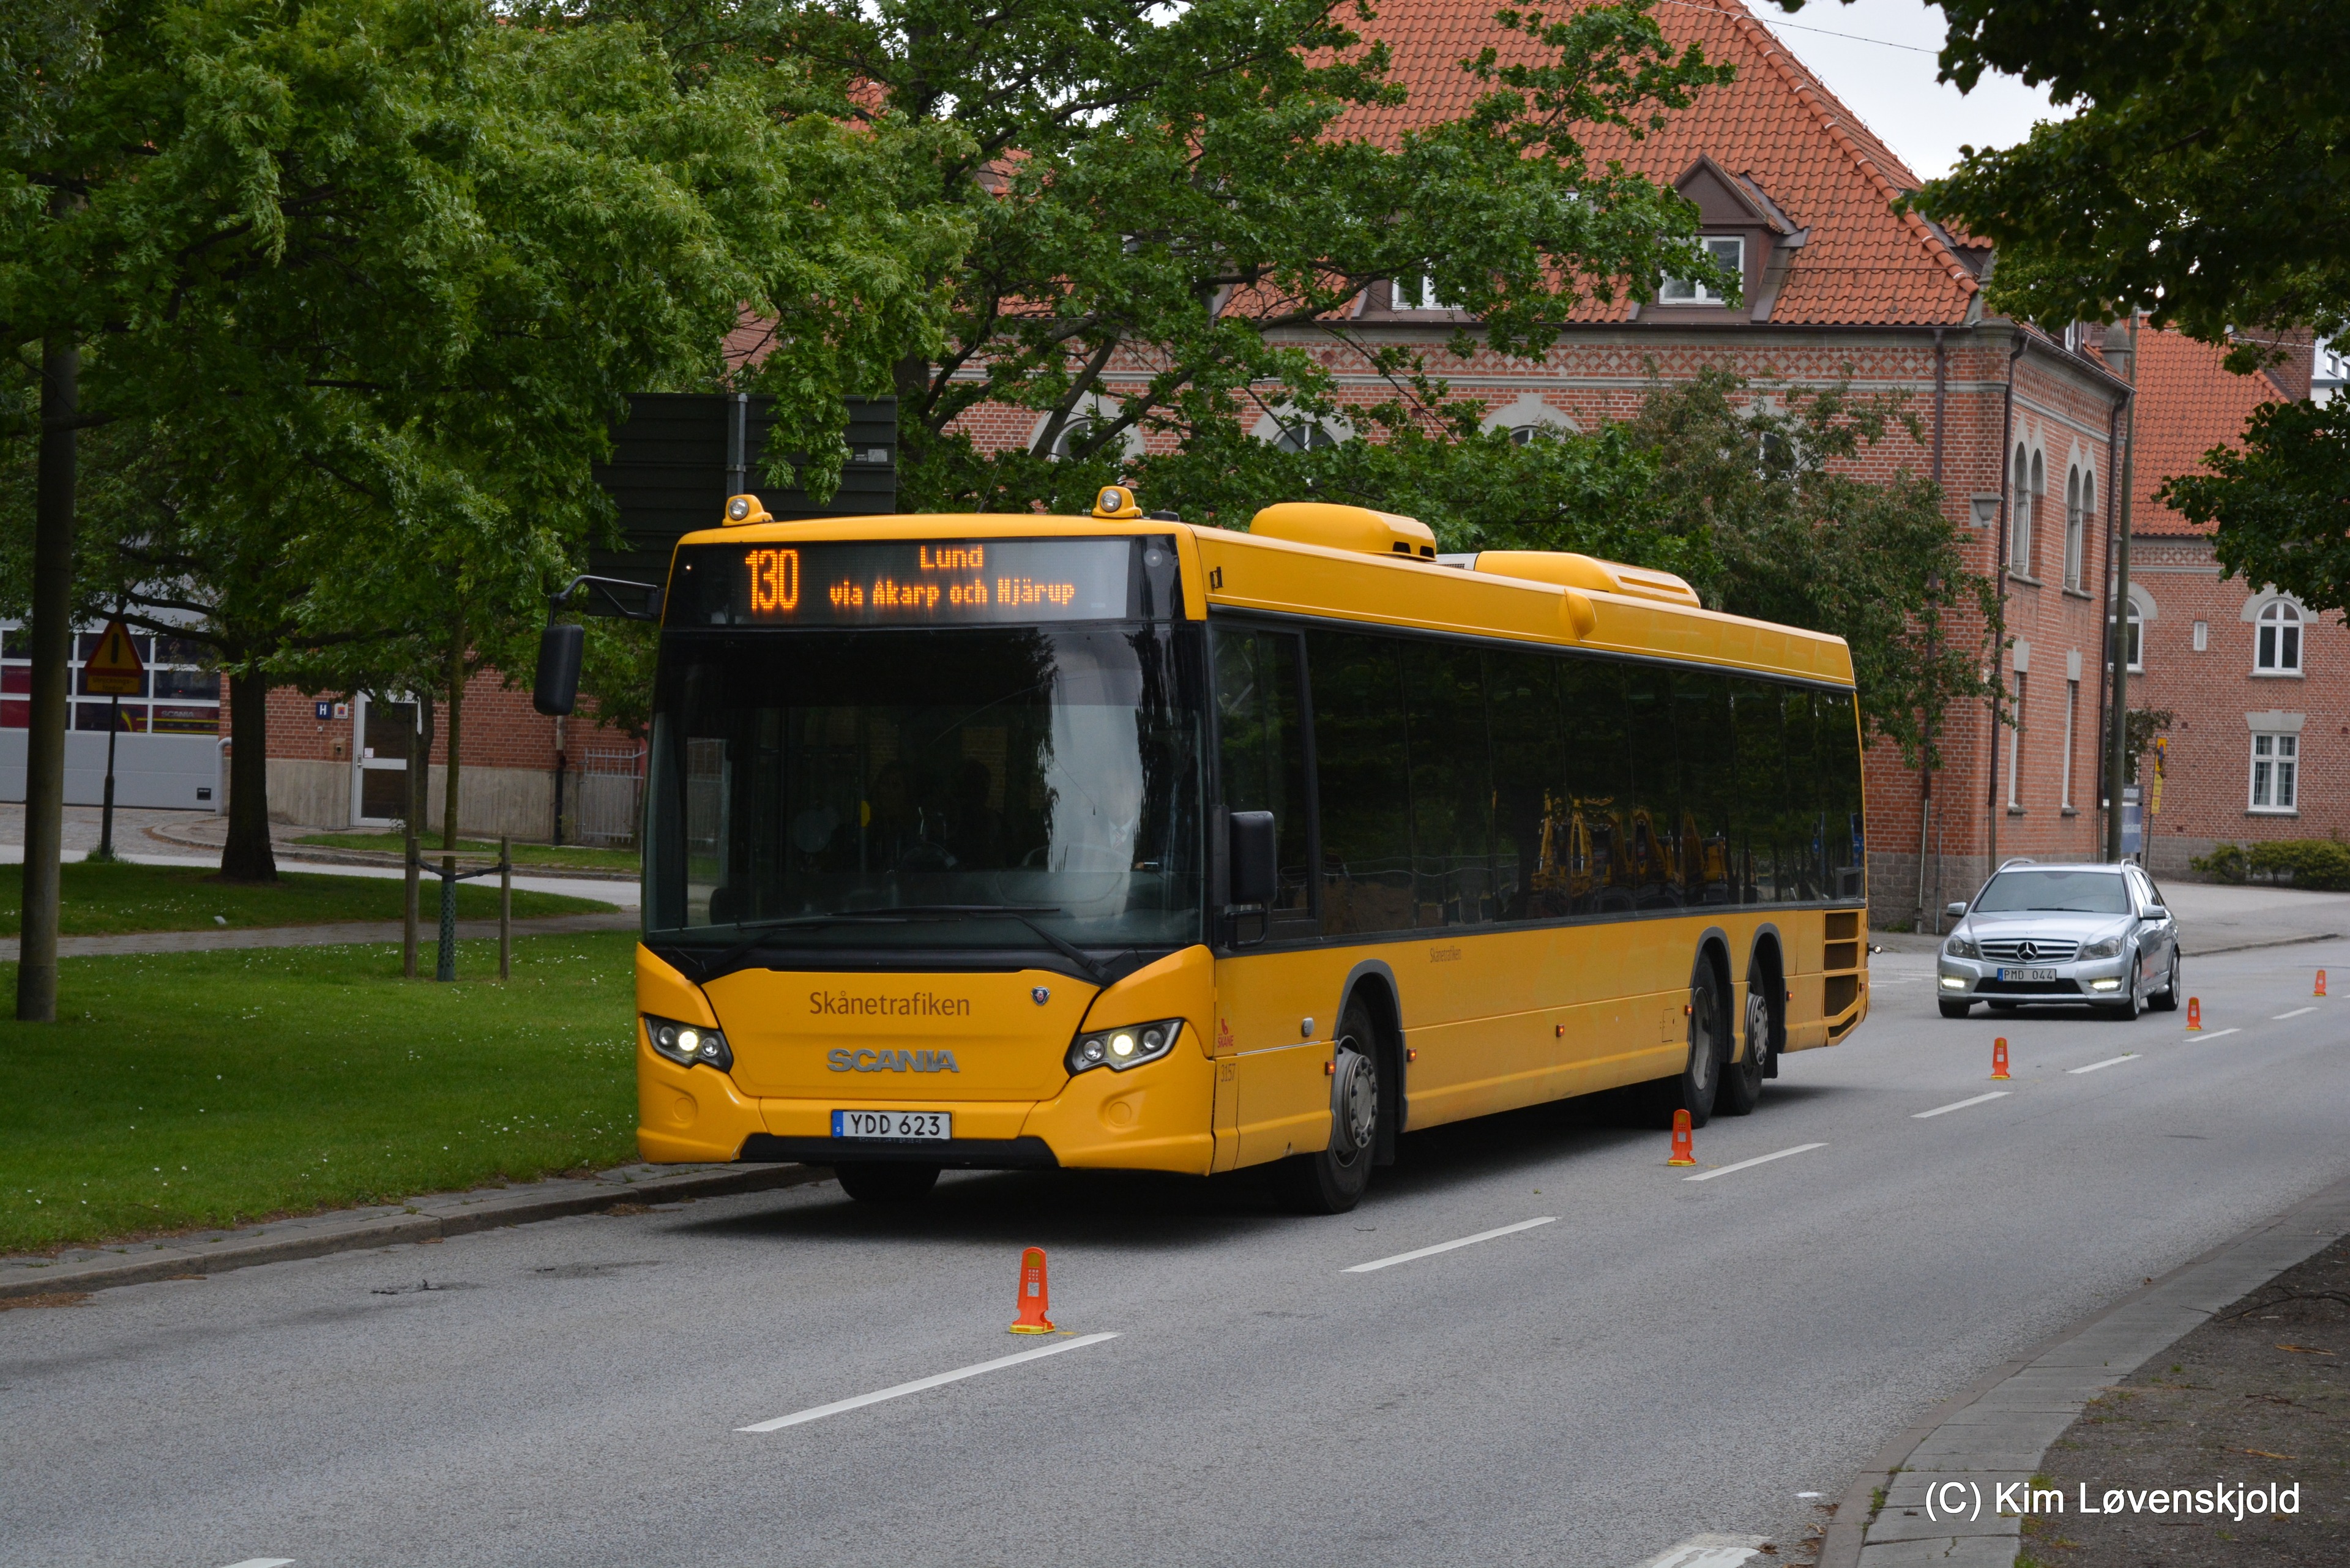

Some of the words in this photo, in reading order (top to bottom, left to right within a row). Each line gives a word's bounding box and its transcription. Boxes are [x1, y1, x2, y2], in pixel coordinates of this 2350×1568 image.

[920, 545, 983, 567] Lund
[745, 550, 797, 609] 130
[830, 579, 862, 604] via
[950, 578, 987, 603] och
[998, 578, 1075, 605] Hjärup
[319, 704, 327, 715] H
[1430, 945, 1461, 963] Skånetrafiken
[2004, 970, 2024, 980] PMD
[2032, 970, 2053, 980] 044
[810, 991, 970, 1016] Skånetrafiken
[827, 1048, 960, 1072] SCANIA
[1221, 1063, 1236, 1082] 3157
[851, 1114, 891, 1135] YDD
[899, 1115, 940, 1136] 623
